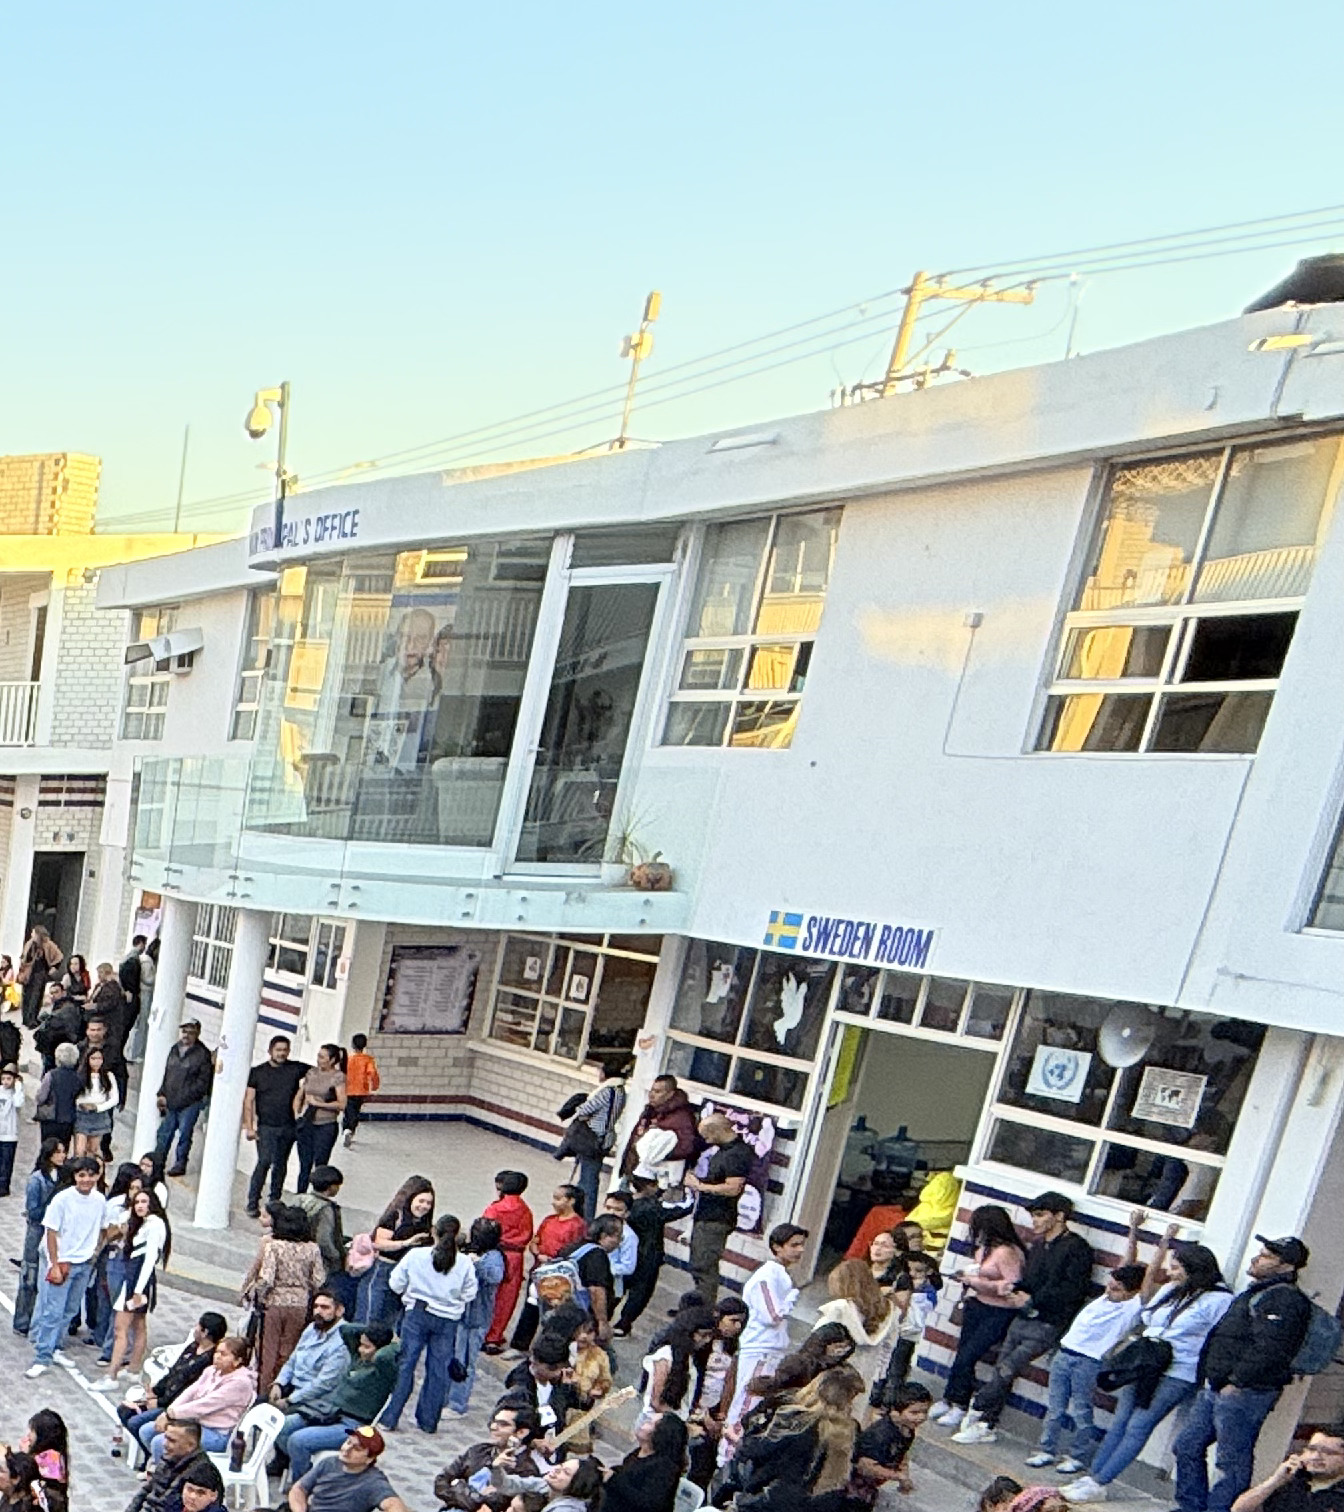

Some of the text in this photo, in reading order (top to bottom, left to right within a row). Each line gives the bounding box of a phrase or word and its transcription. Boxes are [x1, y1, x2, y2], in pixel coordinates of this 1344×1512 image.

[314, 508, 360, 543] OFFICE
[802, 915, 935, 969] SWEDEN ROOM
